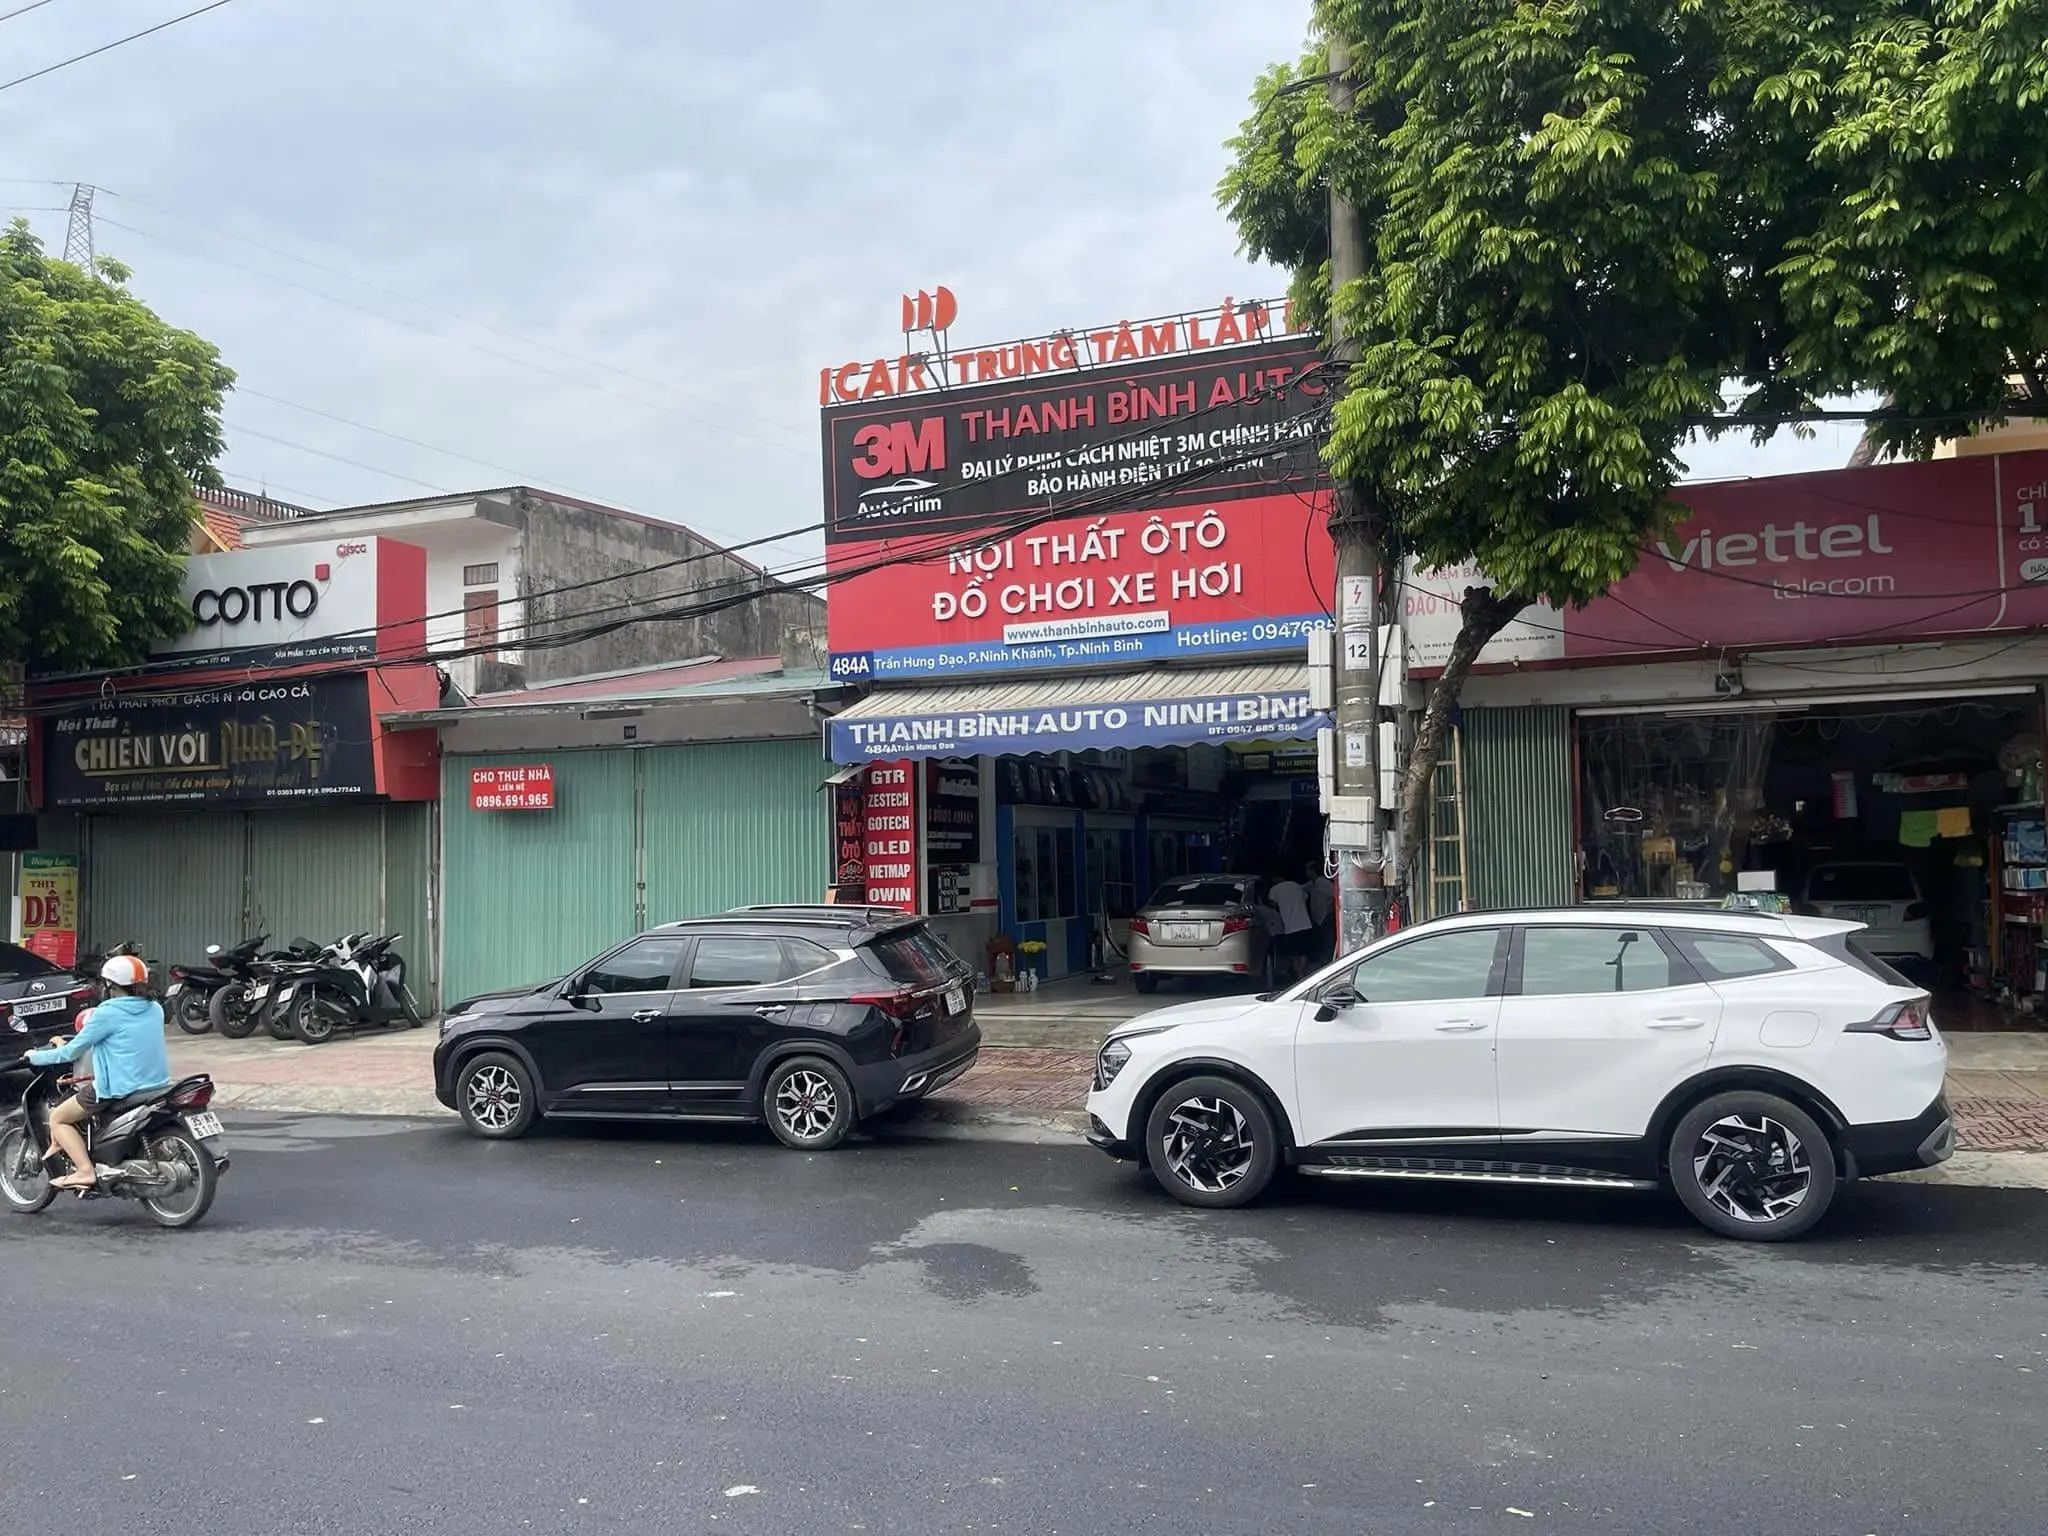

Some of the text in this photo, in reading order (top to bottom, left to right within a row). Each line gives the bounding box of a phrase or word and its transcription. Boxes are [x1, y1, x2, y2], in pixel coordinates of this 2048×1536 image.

[819, 353, 928, 406] ICAR
[951, 334, 1078, 384] TRUNG
[1089, 319, 1176, 364] TÂM
[961, 395, 1093, 441] THANH
[1107, 380, 1197, 423] BÌNH
[851, 416, 945, 479] 3M
[1066, 443, 1113, 468] CÁCH
[1126, 436, 1172, 461] NHIỆT
[1176, 432, 1205, 453] 3M
[1209, 423, 1270, 448] CHÍNH
[1027, 472, 1063, 496] BẢO
[1066, 467, 1116, 492] HÀNH
[1120, 463, 1161, 486] ĐIỆN
[1025, 517, 1125, 566] THẤT
[1141, 509, 1227, 555] ÔTÔ
[1655, 514, 1894, 572] viettel
[931, 562, 1242, 621] ĐỒ CHƠI XE HƠI
[1773, 575, 1895, 600] telecom
[192, 579, 319, 627] COTTO
[1177, 629, 1248, 647] Hotline:
[1348, 643, 1367, 658] 12
[832, 656, 870, 675] 484A
[903, 656, 935, 671] Hưng
[1113, 638, 1143, 652] Bình
[223, 687, 255, 702] NÓI
[258, 688, 287, 701] CAO
[849, 718, 953, 744] THANH
[958, 711, 1029, 737] BÌNH
[1034, 708, 1128, 734] AUTO
[1143, 702, 1229, 727] NINH
[473, 766, 551, 783] CHO THUÊ NHÀ
[870, 769, 905, 785] GTR
[476, 793, 549, 808] 0896.691.965
[498, 784, 512, 792] LIÊN
[868, 792, 909, 808] ZESTECH
[868, 815, 910, 831] GOTECH
[868, 840, 910, 855] OLED
[869, 864, 910, 879] VIETMAP
[869, 887, 911, 902] OWIN
[24, 889, 60, 928] DÊ
